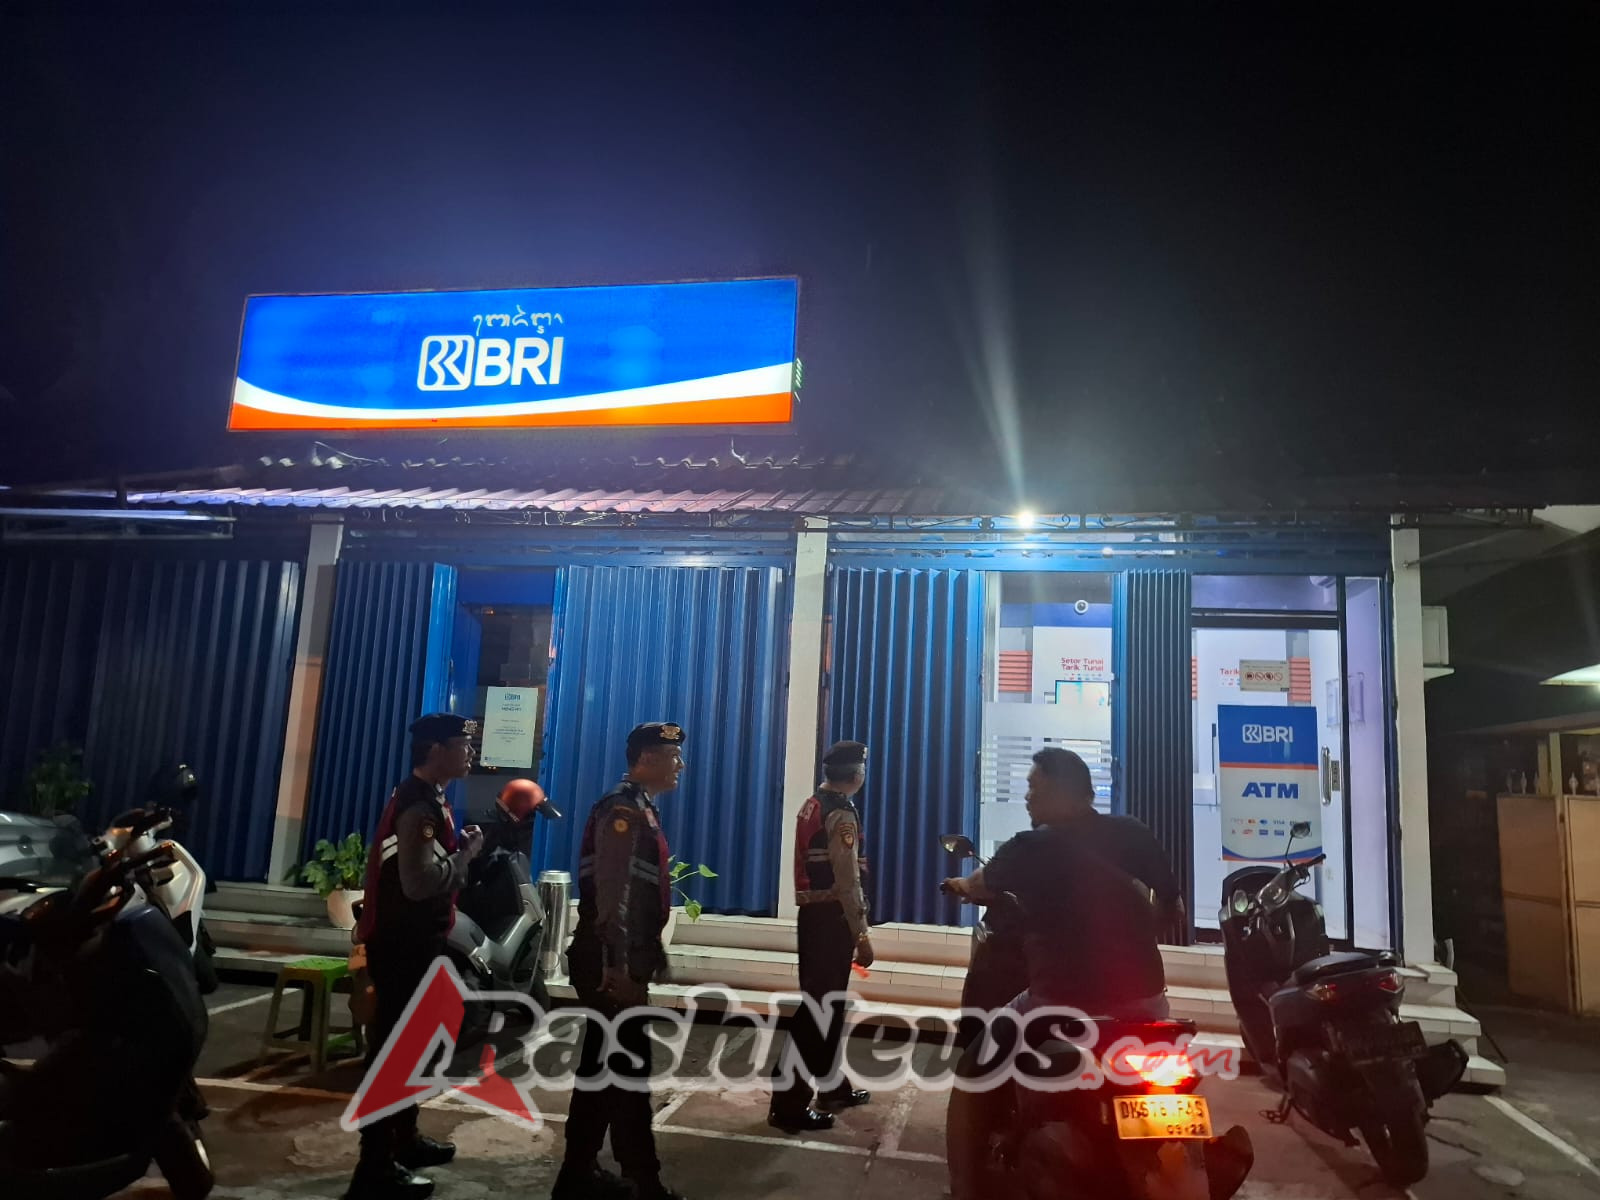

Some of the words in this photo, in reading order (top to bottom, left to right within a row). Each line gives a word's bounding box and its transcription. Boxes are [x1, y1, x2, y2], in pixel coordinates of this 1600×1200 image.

[474, 336, 564, 386] BRI
[1219, 668, 1240, 676] Tarik
[1262, 725, 1293, 743] BRI
[1242, 782, 1299, 799] ATM
